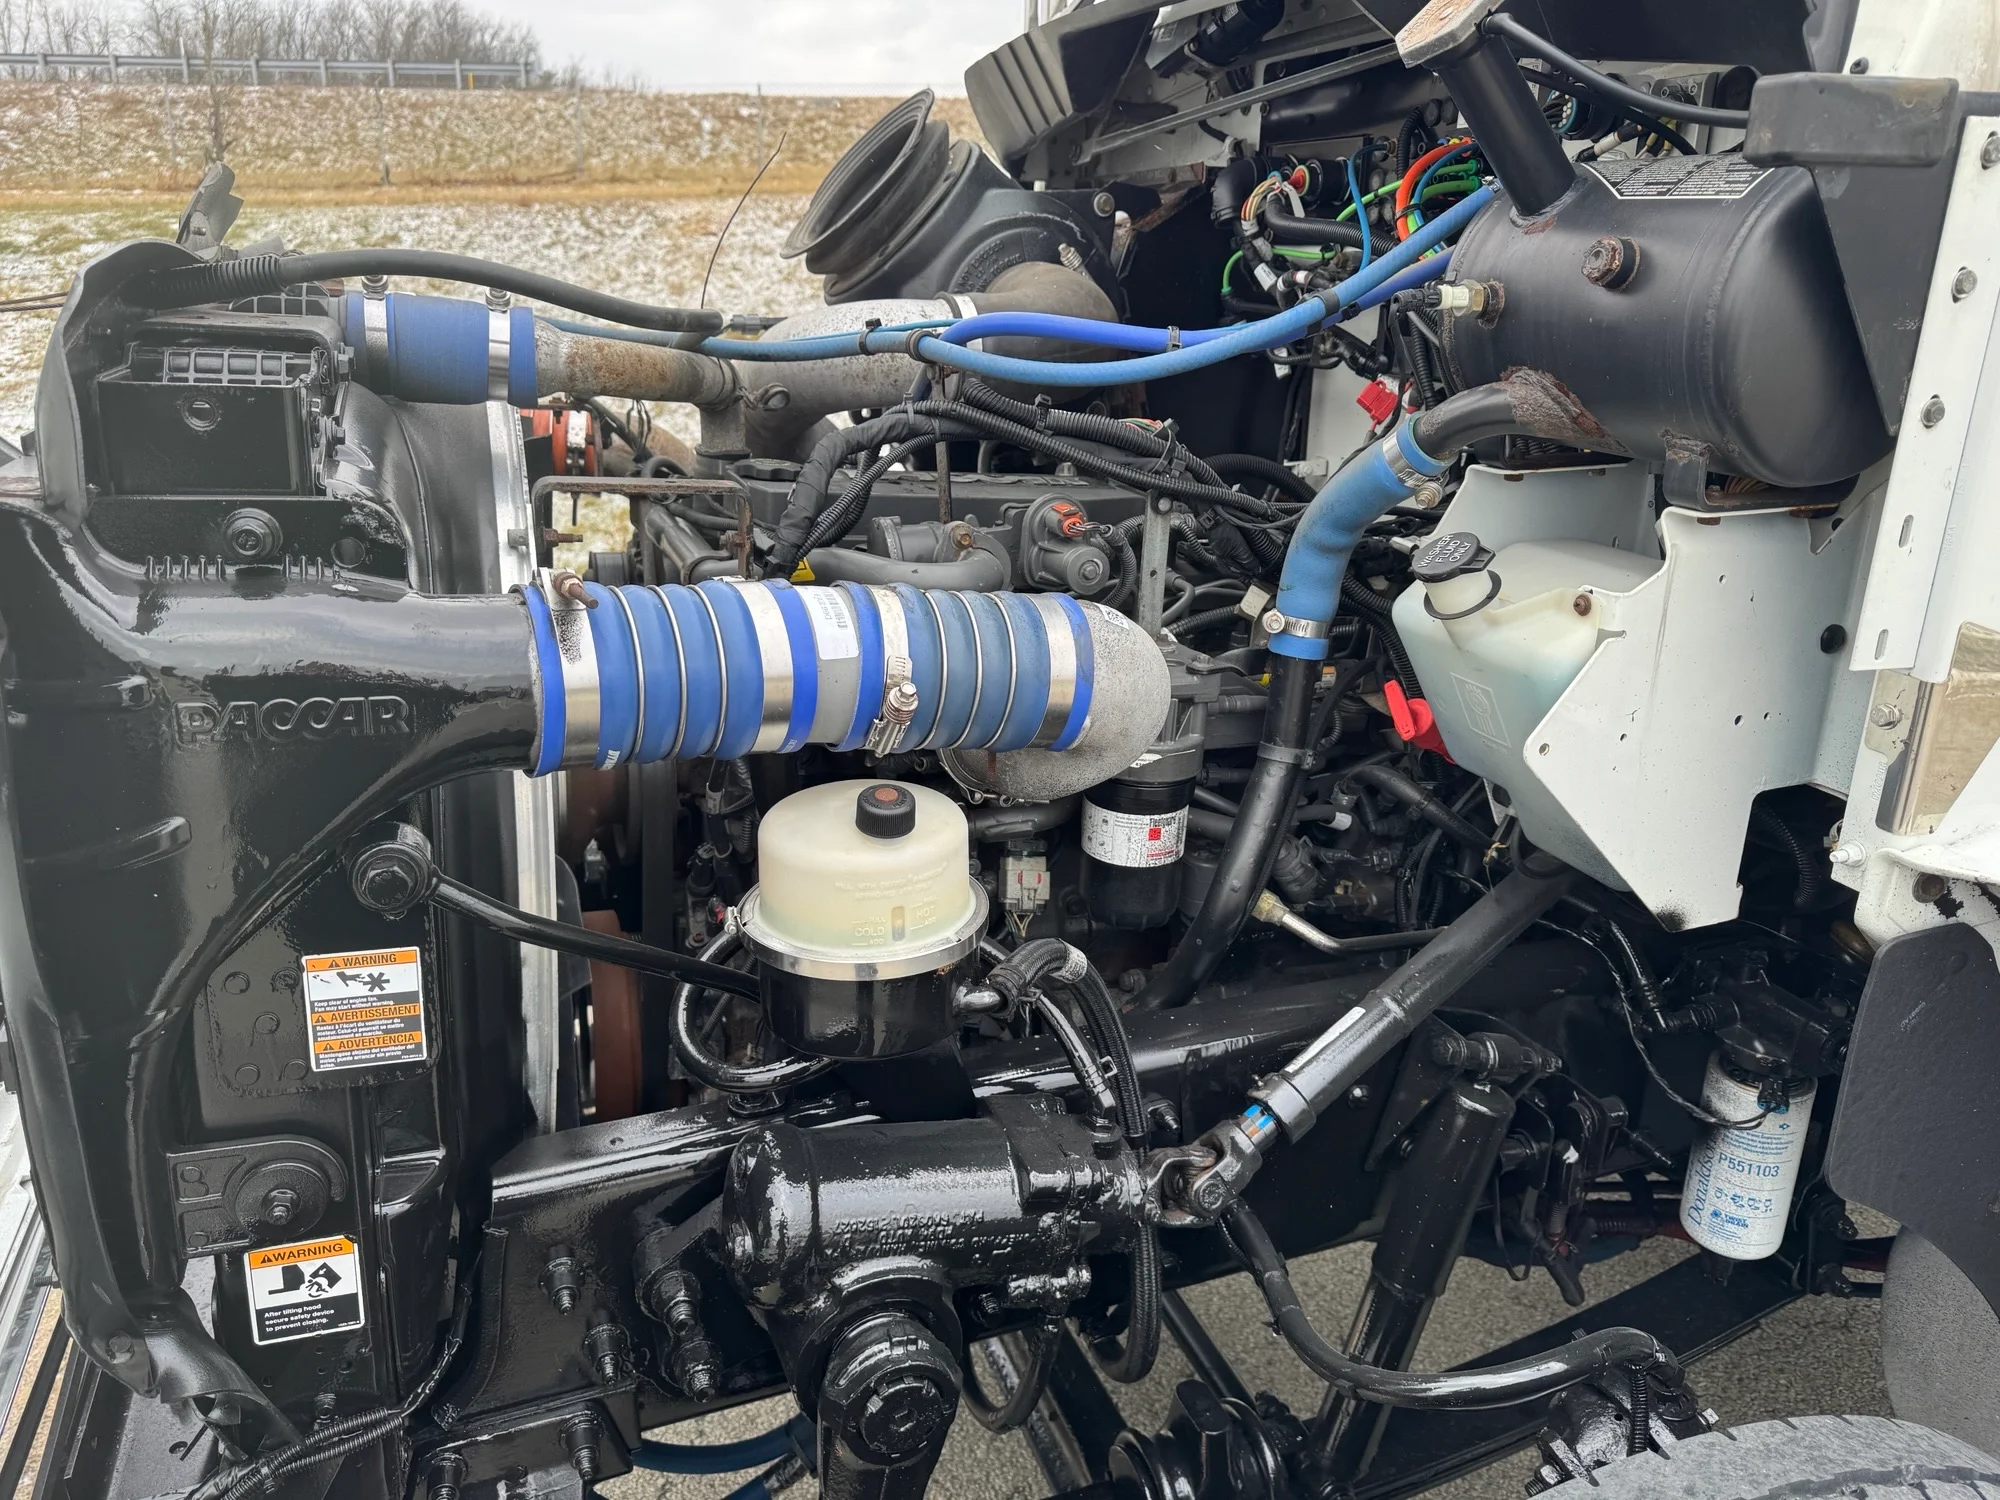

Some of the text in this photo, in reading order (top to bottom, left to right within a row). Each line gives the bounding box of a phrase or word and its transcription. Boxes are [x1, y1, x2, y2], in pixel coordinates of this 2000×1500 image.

[1417, 534, 1454, 568] WASHER
[1435, 540, 1461, 563] FLUID
[1449, 541, 1472, 562] ONLY
[172, 695, 410, 745] PACCAR
[916, 905, 935, 919] HOT
[924, 917, 936, 926] ADD
[855, 926, 885, 937] COLD
[342, 954, 396, 967] WARNING
[331, 1005, 418, 1022] AVERTISSEMENT
[338, 1034, 415, 1049] ADVERTENCIA
[1718, 1152, 1780, 1177] P551103
[1688, 1139, 1717, 1226] Donaldson
[1724, 1213, 1747, 1223] TWIST
[273, 1243, 343, 1261] WARNING
[290, 1314, 311, 1322] safety
[312, 1309, 334, 1317] device
[275, 1322, 301, 1331] prevent
[302, 1318, 328, 1326] closing.
